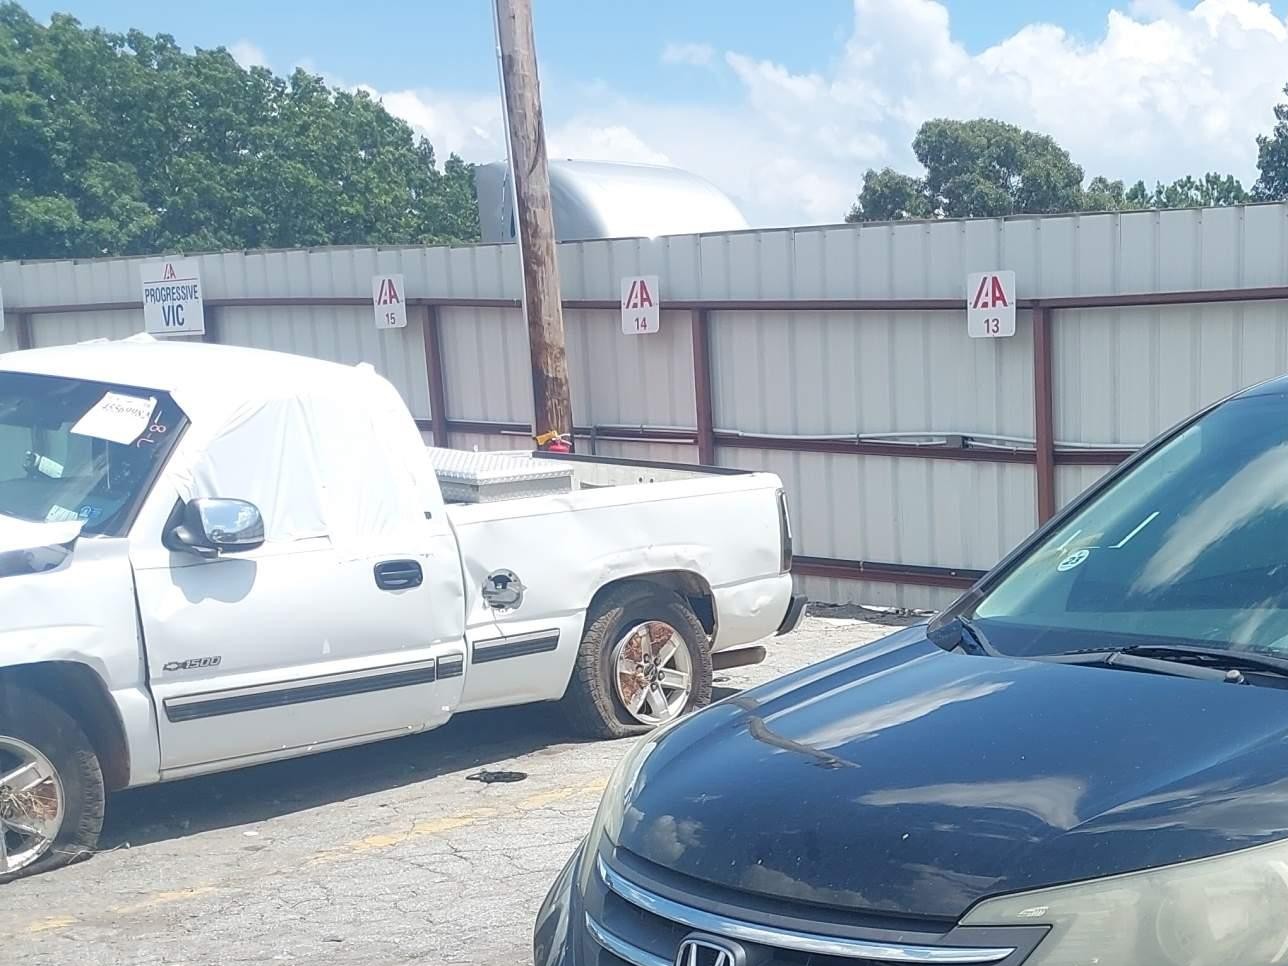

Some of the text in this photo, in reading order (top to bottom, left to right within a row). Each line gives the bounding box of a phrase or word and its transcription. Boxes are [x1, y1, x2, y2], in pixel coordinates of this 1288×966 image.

[144, 284, 199, 304] PROGRESSIVE
[162, 304, 185, 327] VIC
[385, 312, 396, 325] 15
[634, 317, 647, 331] 14
[984, 318, 1000, 334] 13
[185, 656, 222, 669] 1500
